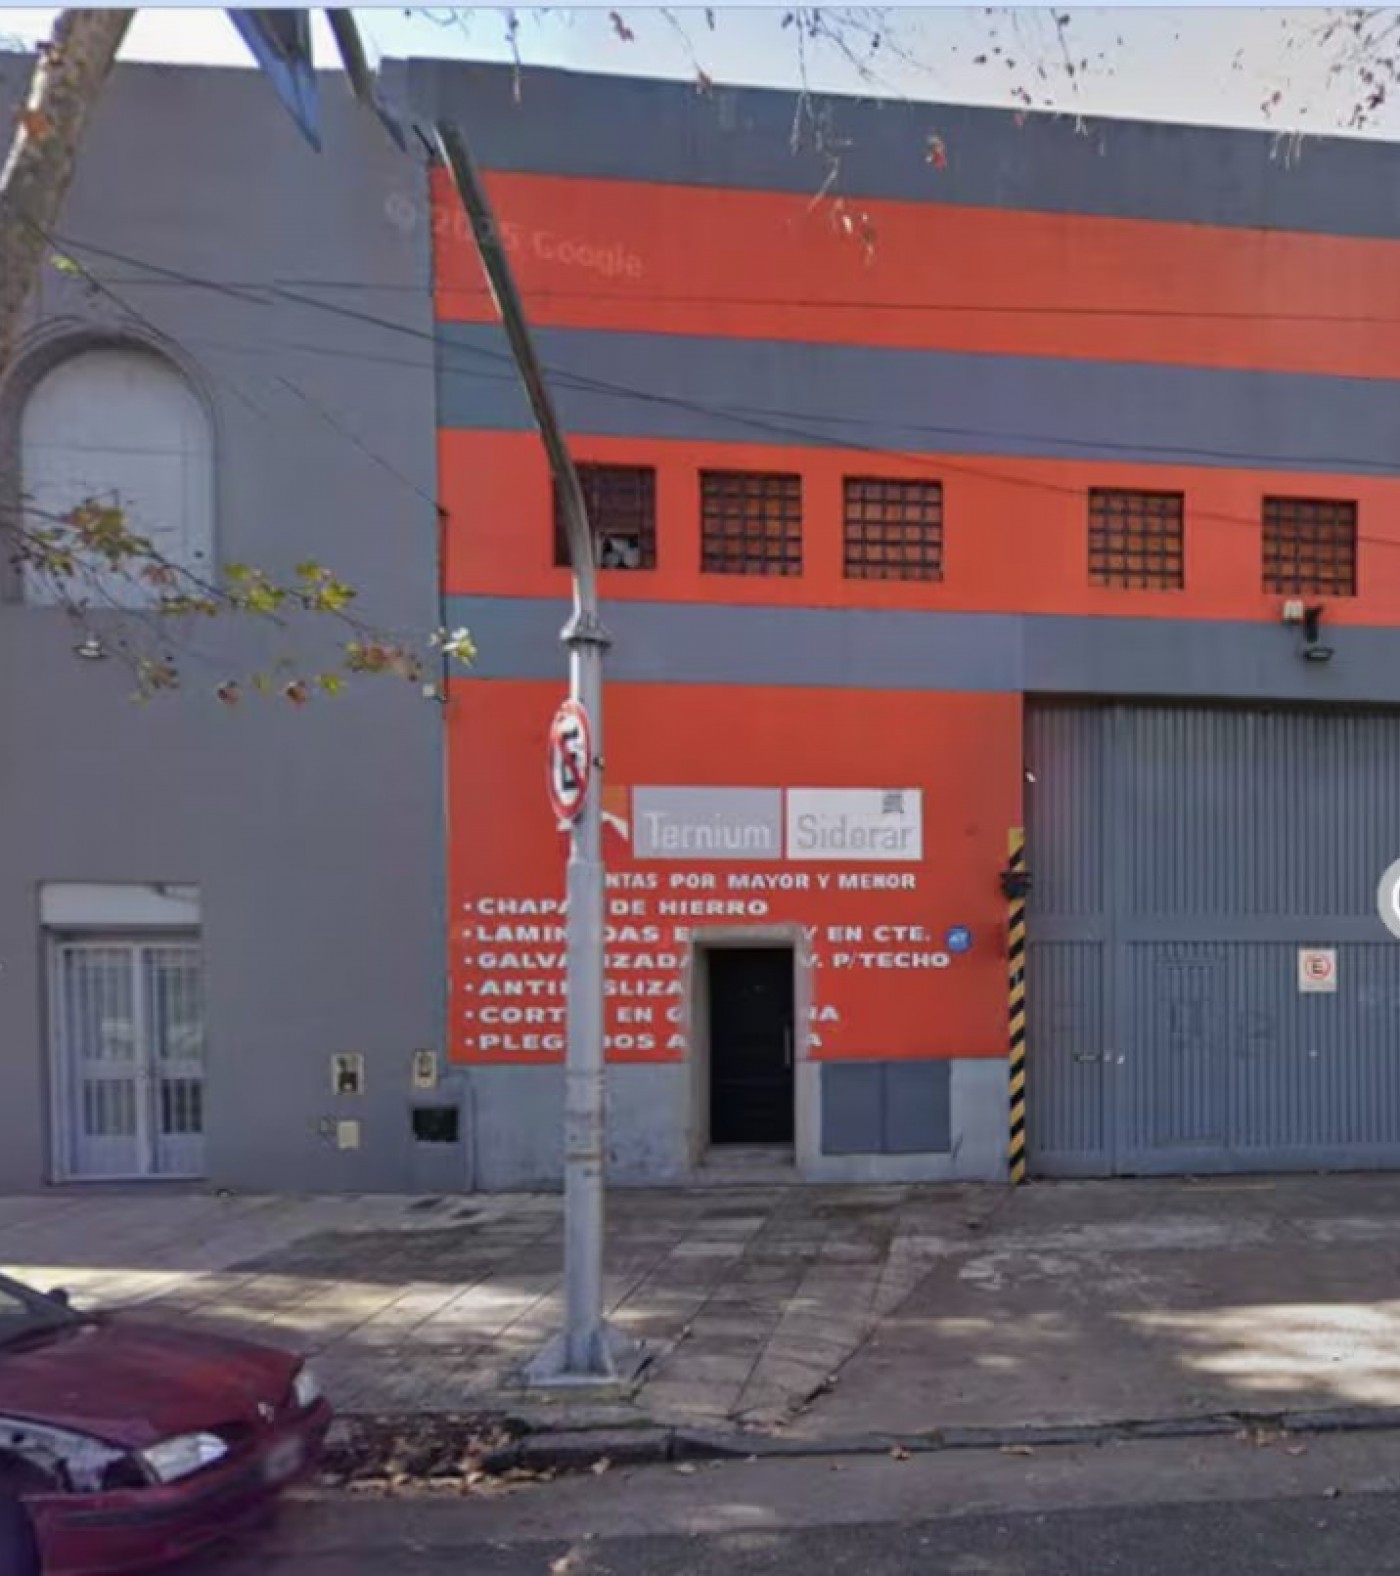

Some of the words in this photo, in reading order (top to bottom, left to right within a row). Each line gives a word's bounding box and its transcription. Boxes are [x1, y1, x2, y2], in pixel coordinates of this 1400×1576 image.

[642, 809, 772, 850] Ternium
[796, 813, 913, 850] Siderar
[604, 873, 658, 889] NTAS
[669, 873, 715, 889] POR
[728, 873, 810, 890] MAYOR
[817, 873, 831, 889] Y
[838, 873, 916, 889] MENOR
[476, 898, 569, 916] CHAPA
[610, 899, 647, 916] DE
[658, 899, 769, 916] HIERRO
[477, 925, 660, 942] LAMINDAS
[827, 926, 863, 942] EN
[873, 925, 932, 942] CTE.
[833, 952, 950, 969] P/TECHO
[479, 1006, 568, 1023] CORT
[616, 1007, 652, 1023] EN
[479, 1034, 655, 1050] PLEGOS
